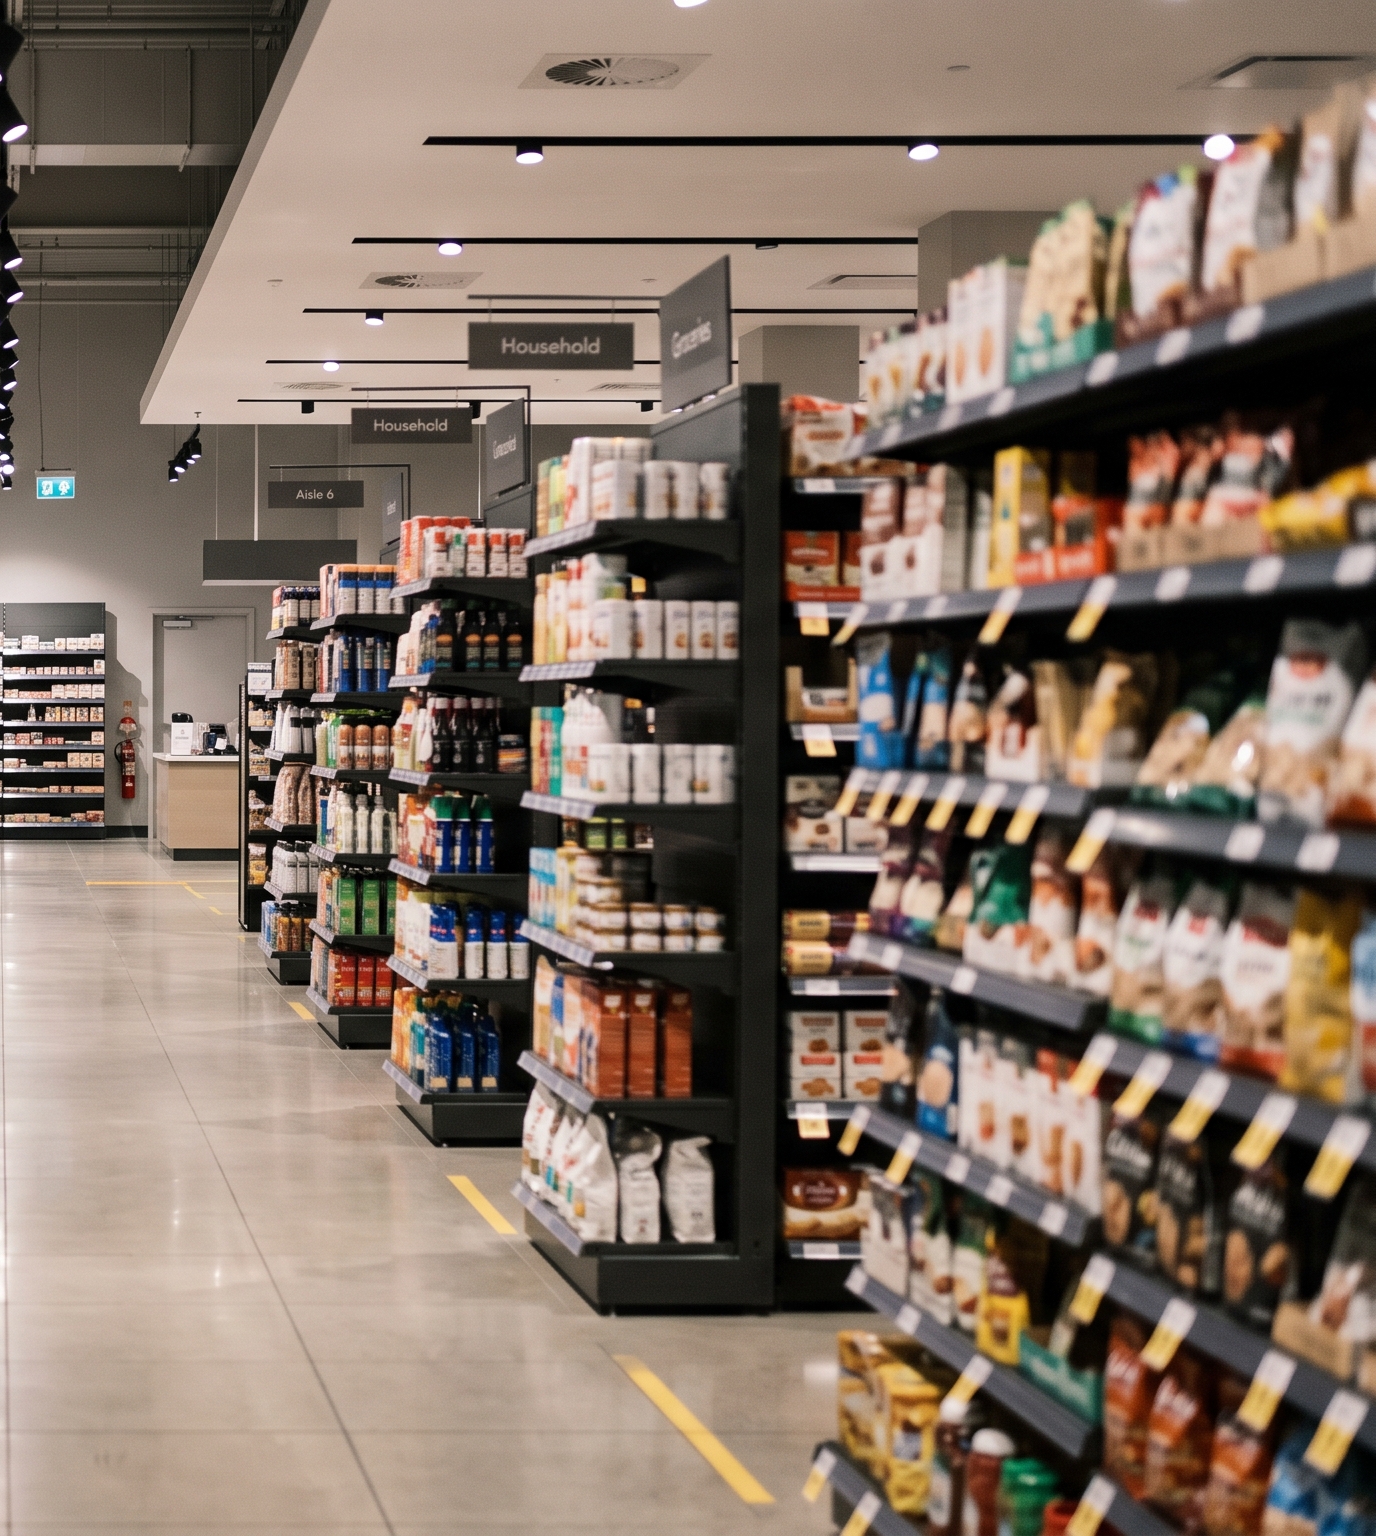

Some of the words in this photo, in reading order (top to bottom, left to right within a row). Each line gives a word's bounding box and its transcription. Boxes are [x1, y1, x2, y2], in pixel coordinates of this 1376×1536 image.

[501, 336, 601, 355] Household
[295, 488, 324, 500] Aisle
[326, 488, 335, 500] 6
